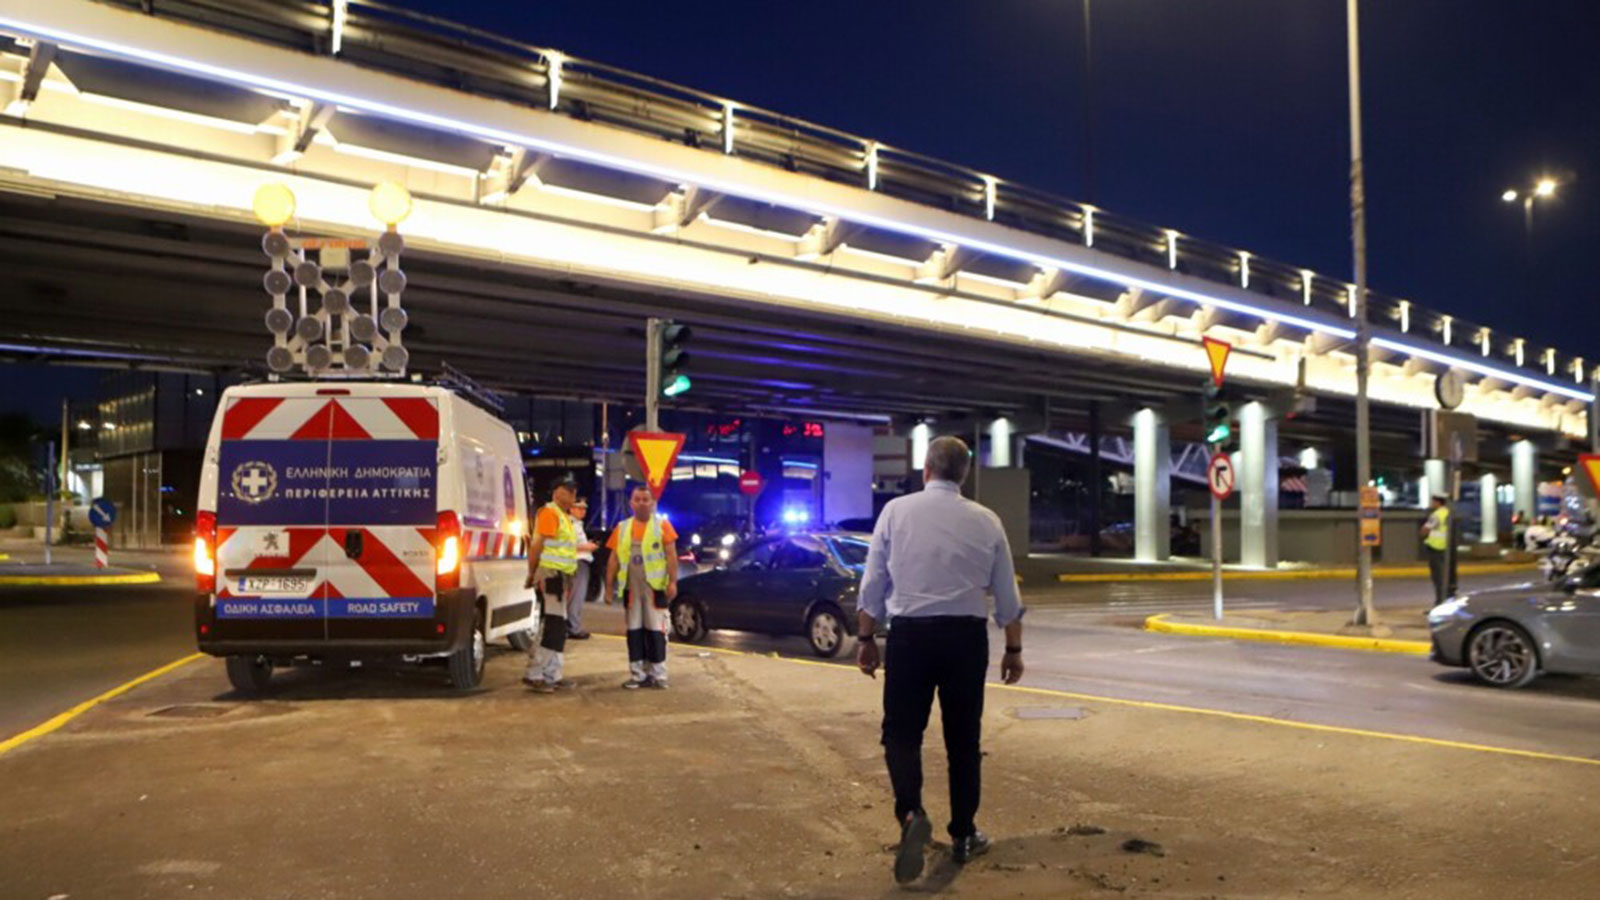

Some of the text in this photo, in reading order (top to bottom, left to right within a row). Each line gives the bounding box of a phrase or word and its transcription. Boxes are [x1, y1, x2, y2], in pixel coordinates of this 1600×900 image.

[286, 467, 431, 479] ΕΛΛΗΝΙΚΗ ΔΗΜΟΚΡΑΤΙΑ
[285, 488, 430, 498] ΠΕΡΙΦΕΡΕΙΑ ΑΤΤΙΚΗΣ
[224, 603, 315, 614] ΟΔΙΚΗ ΑΣΦΑΛΕΙΑ
[347, 602, 419, 614] ROAD SAFETY
